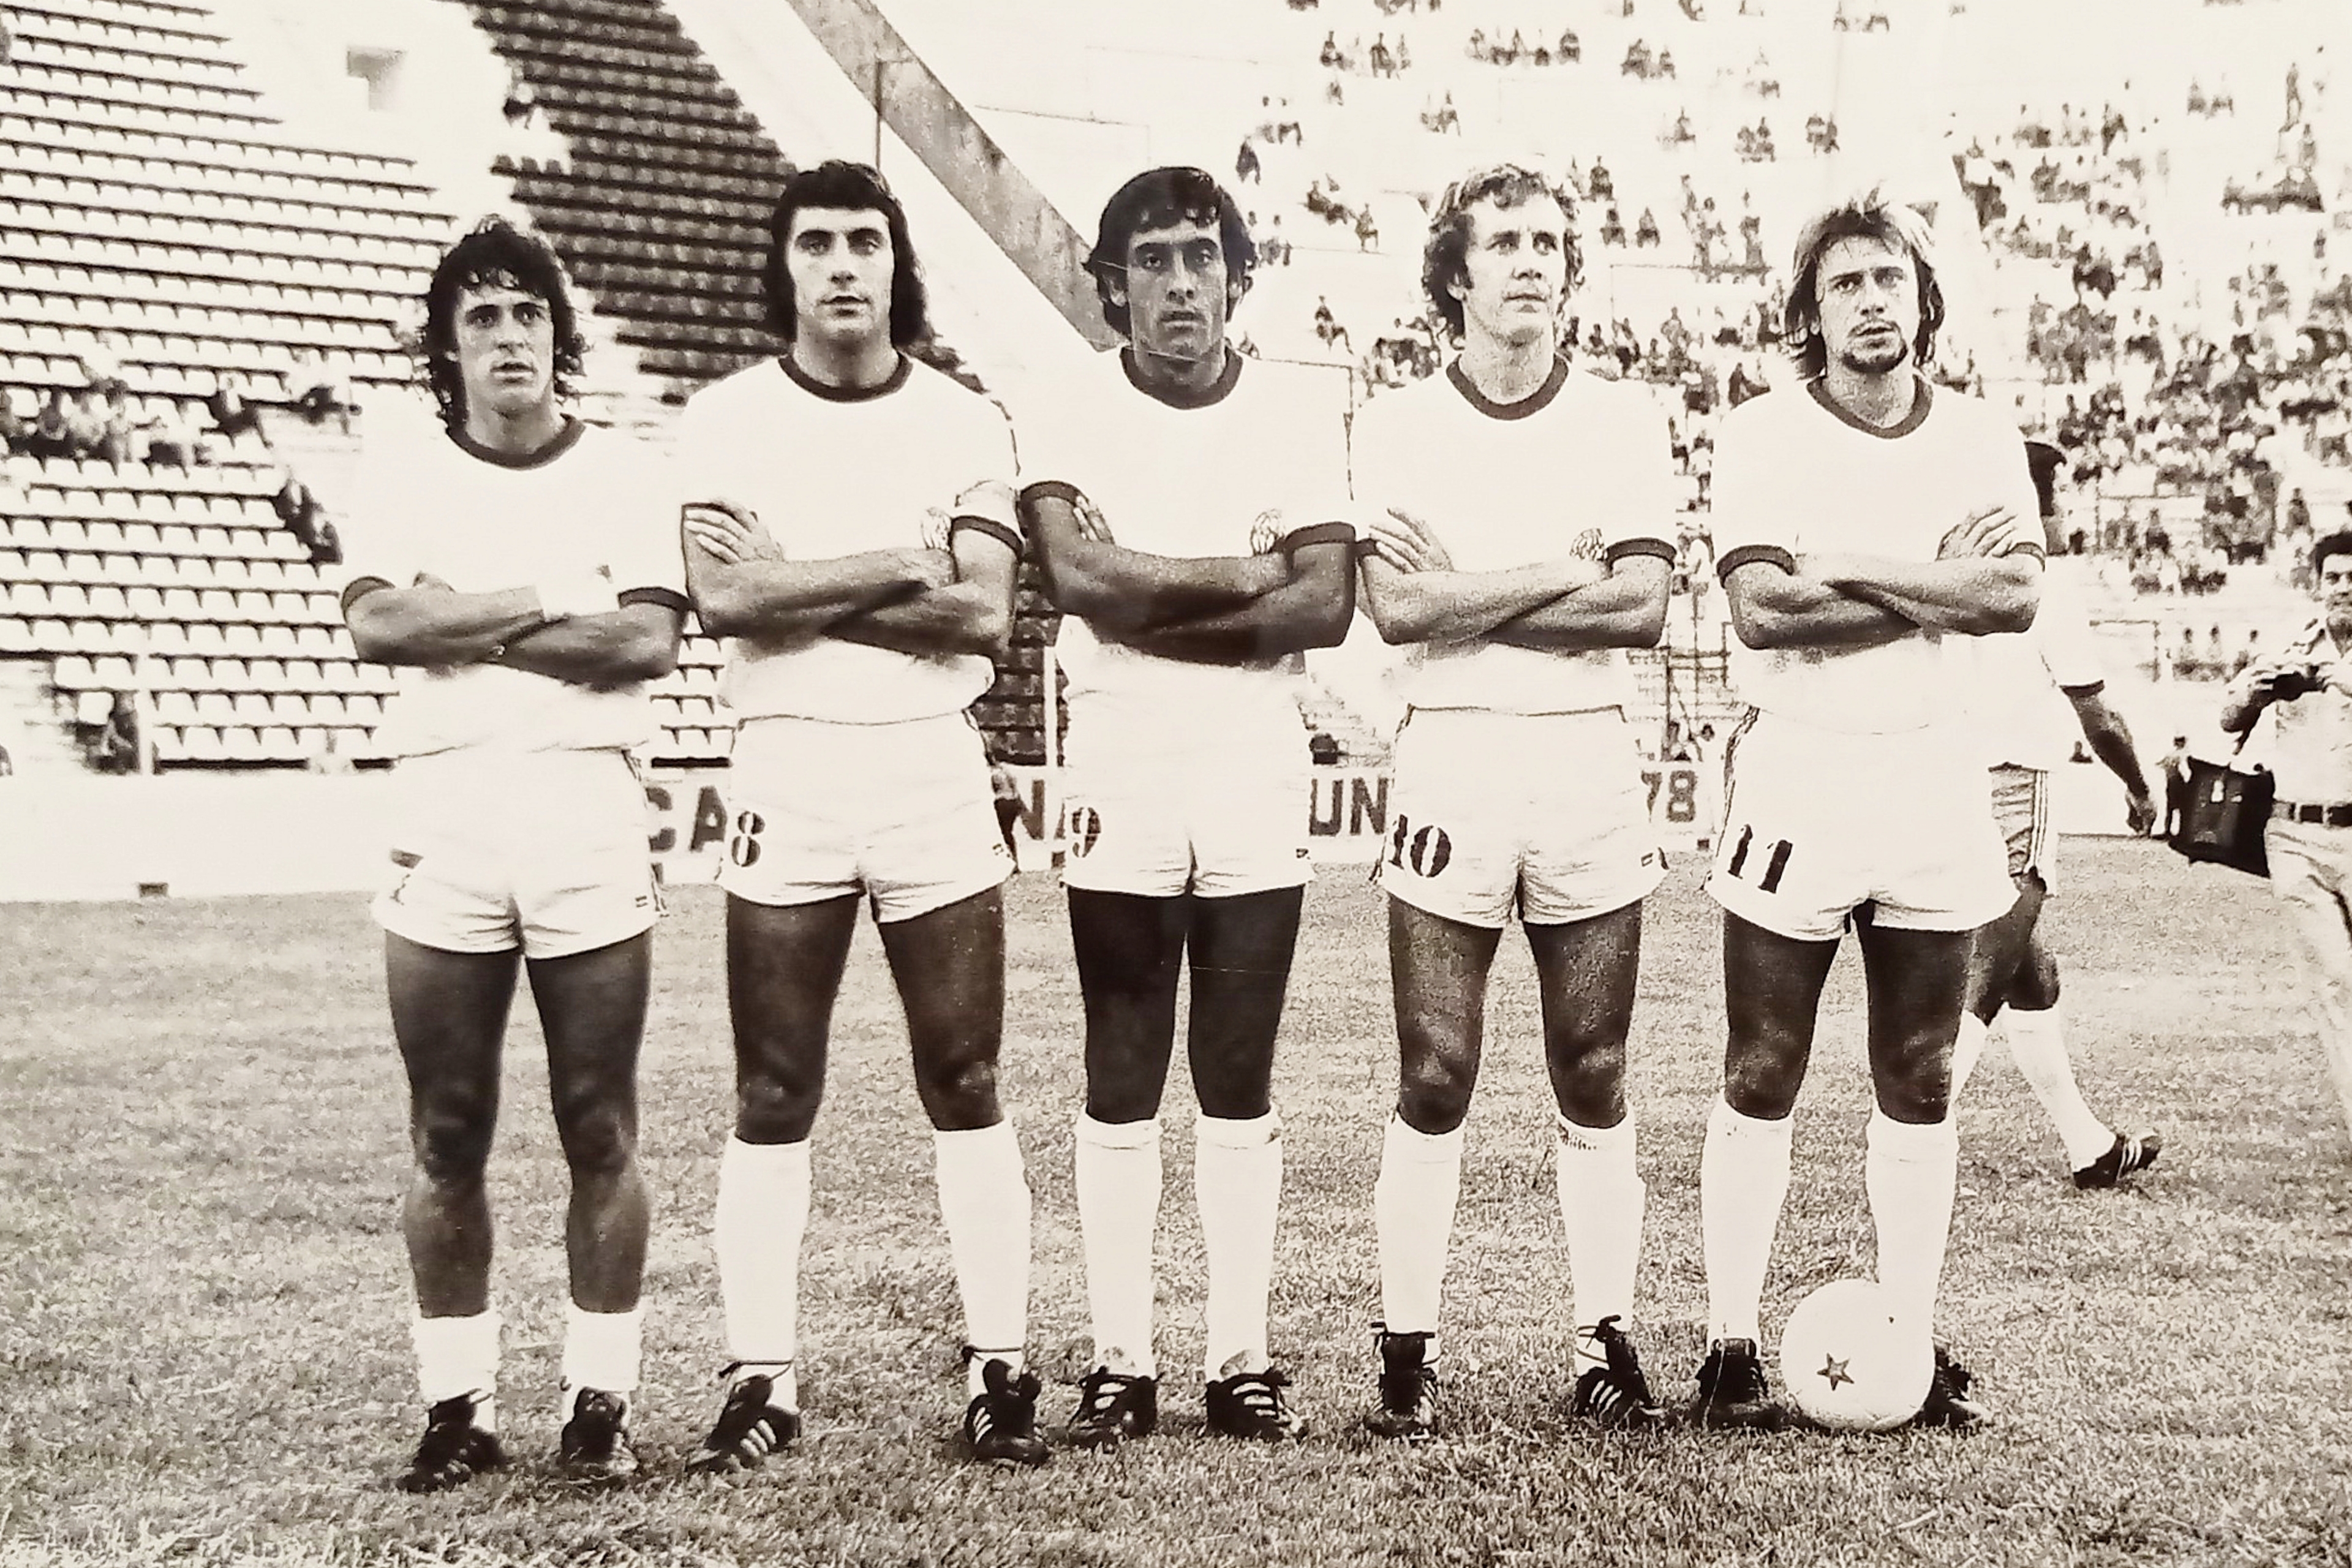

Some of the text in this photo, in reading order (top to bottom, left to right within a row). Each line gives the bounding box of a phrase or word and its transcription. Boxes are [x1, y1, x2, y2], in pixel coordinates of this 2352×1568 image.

[1641, 770, 1697, 823] 78
[731, 810, 766, 868] 8
[1072, 806, 1101, 858] 9
[1388, 814, 1452, 878] 10
[1728, 824, 1793, 894] 11
